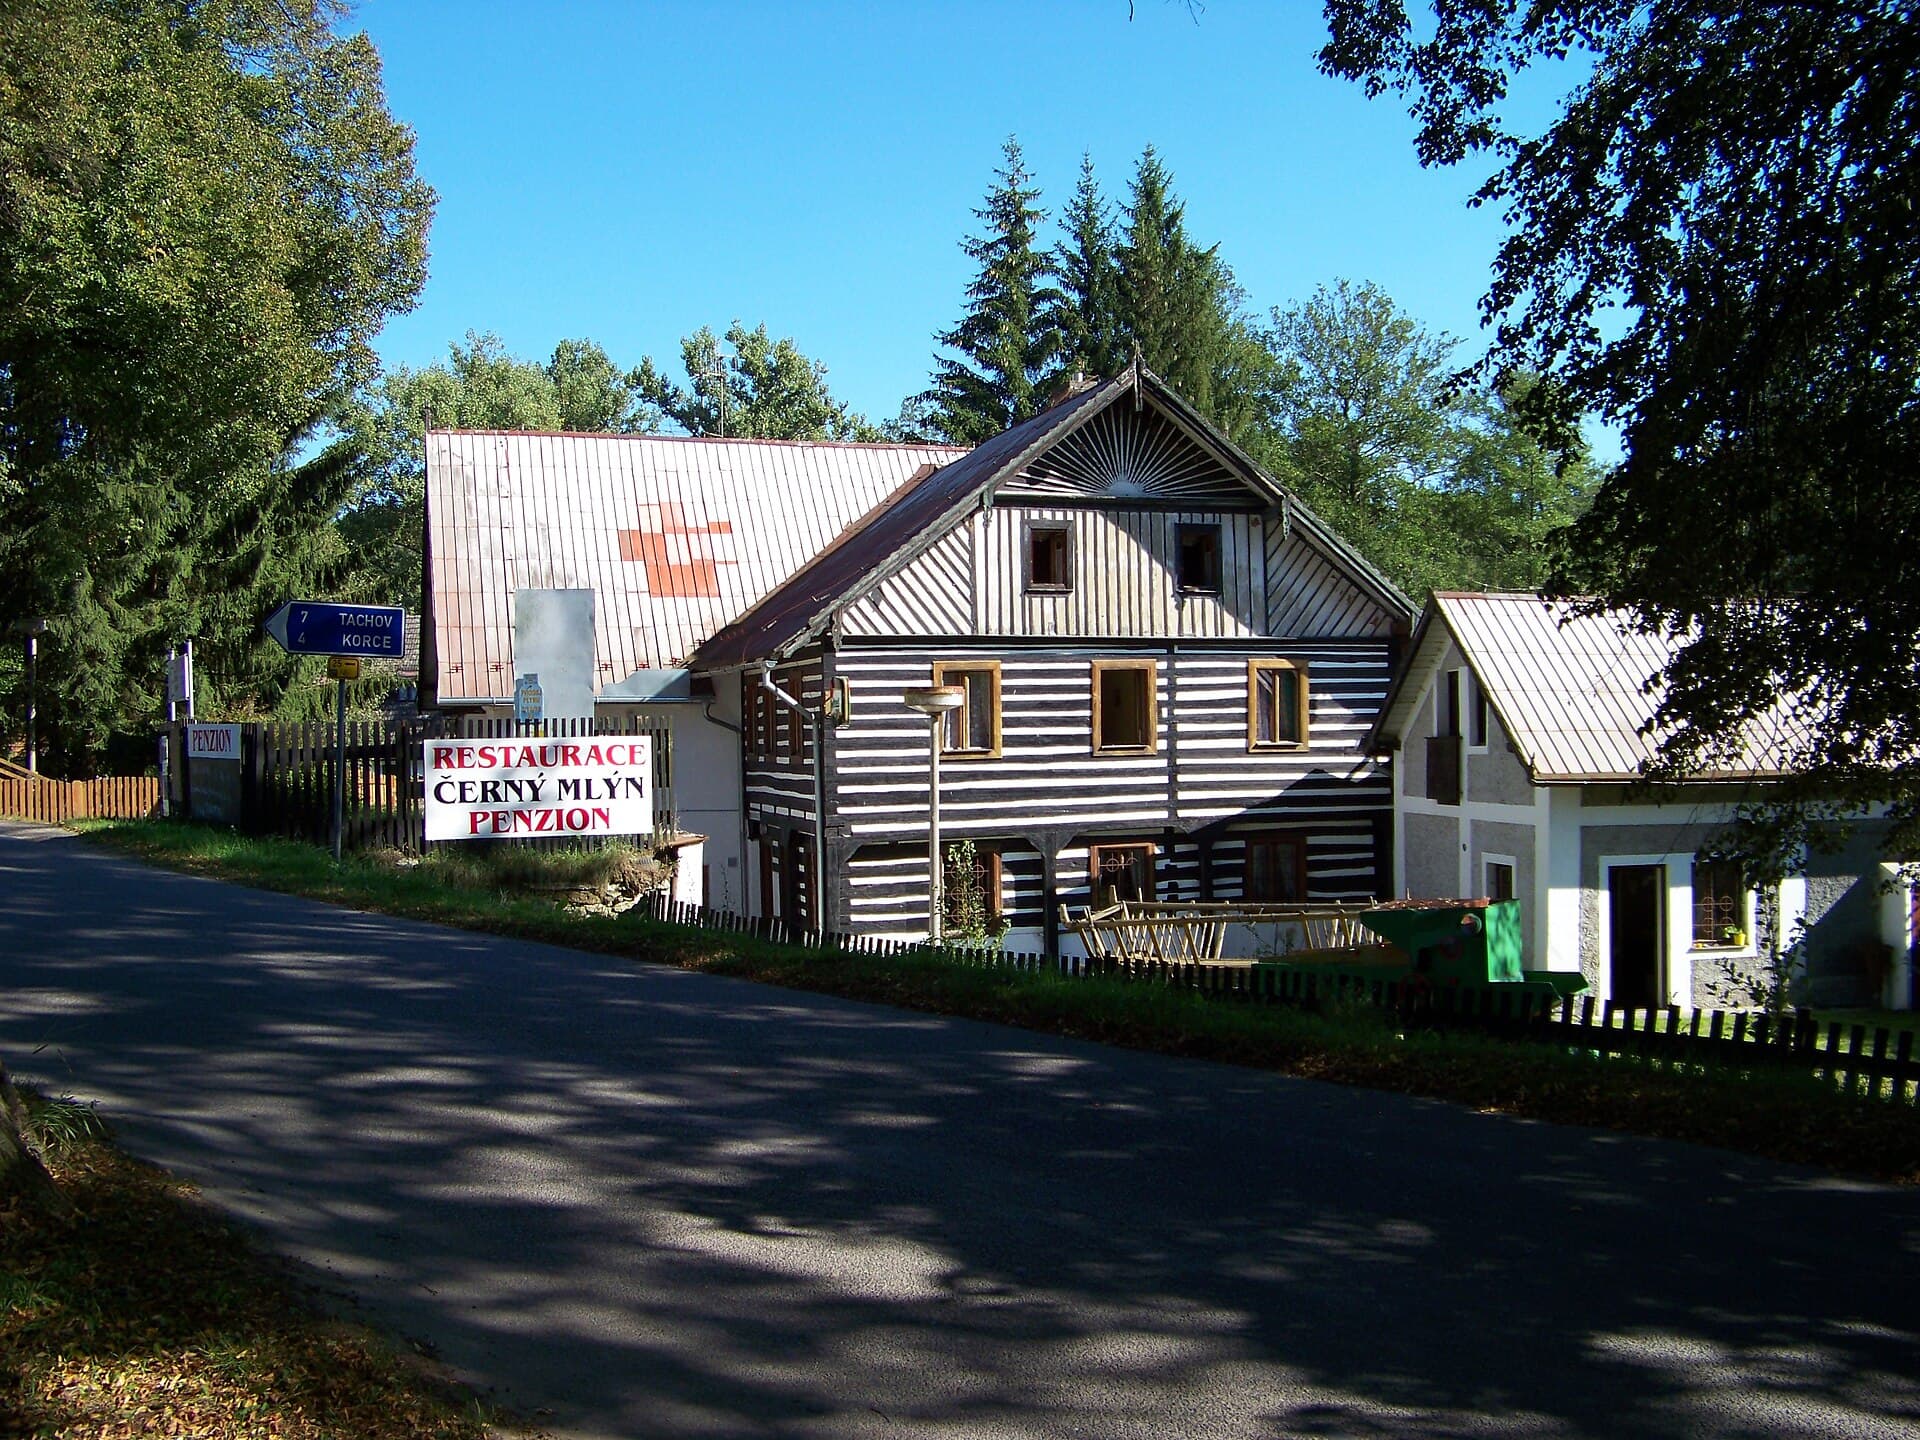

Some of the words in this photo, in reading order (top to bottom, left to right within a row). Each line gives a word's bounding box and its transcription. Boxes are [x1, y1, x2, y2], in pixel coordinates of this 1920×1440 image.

[301, 611, 308, 623] 7
[339, 613, 393, 628] TACHOV
[298, 632, 305, 644] 4
[342, 634, 392, 649] KORCE
[192, 729, 232, 752] PENZION
[432, 744, 646, 769] RESTAURACE
[433, 772, 547, 804] ČERNÝ
[558, 770, 644, 801] MLÝN
[469, 807, 610, 835] PENZION
